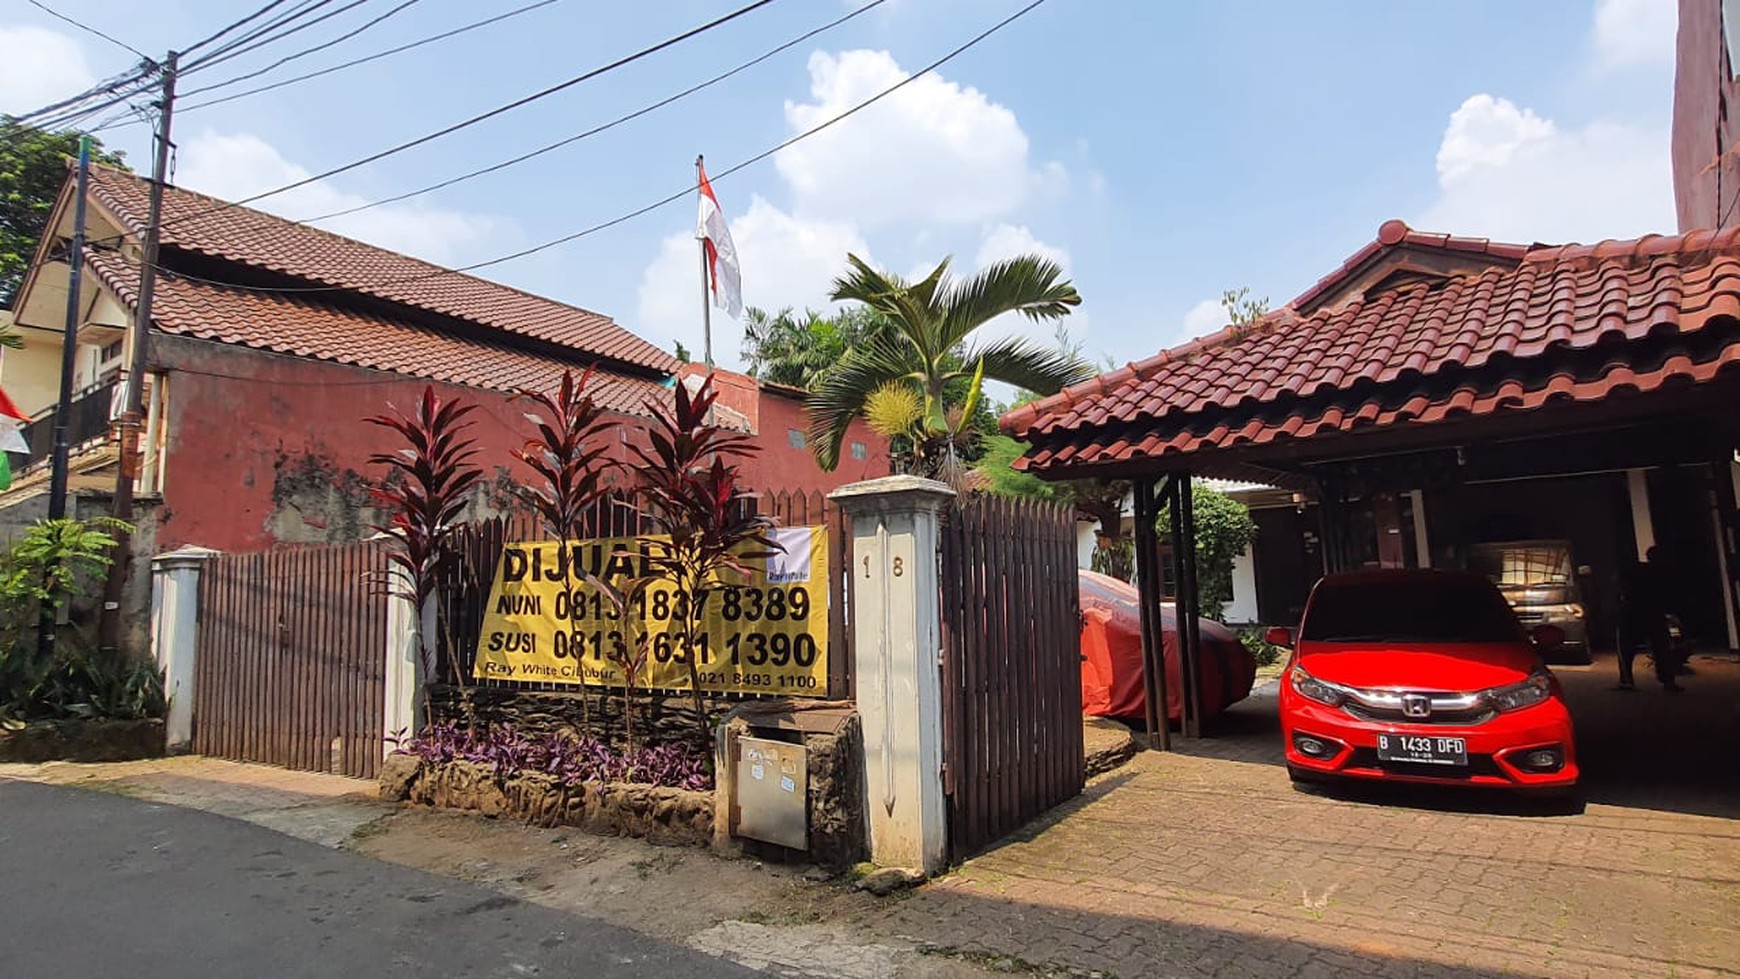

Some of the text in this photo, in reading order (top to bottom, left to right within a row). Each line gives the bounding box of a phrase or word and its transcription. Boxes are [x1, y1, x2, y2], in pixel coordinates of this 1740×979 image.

[503, 543, 667, 582] DIJUAL
[496, 595, 541, 615] NUNI
[722, 586, 811, 621] 8389
[488, 632, 536, 653] SUSI
[554, 630, 624, 661] 0813
[726, 632, 816, 667] 1390
[484, 662, 516, 675] Ray
[522, 664, 557, 675] White
[700, 672, 816, 688] 021 8493 1100
[1379, 735, 1463, 754] B 1433 DFD
